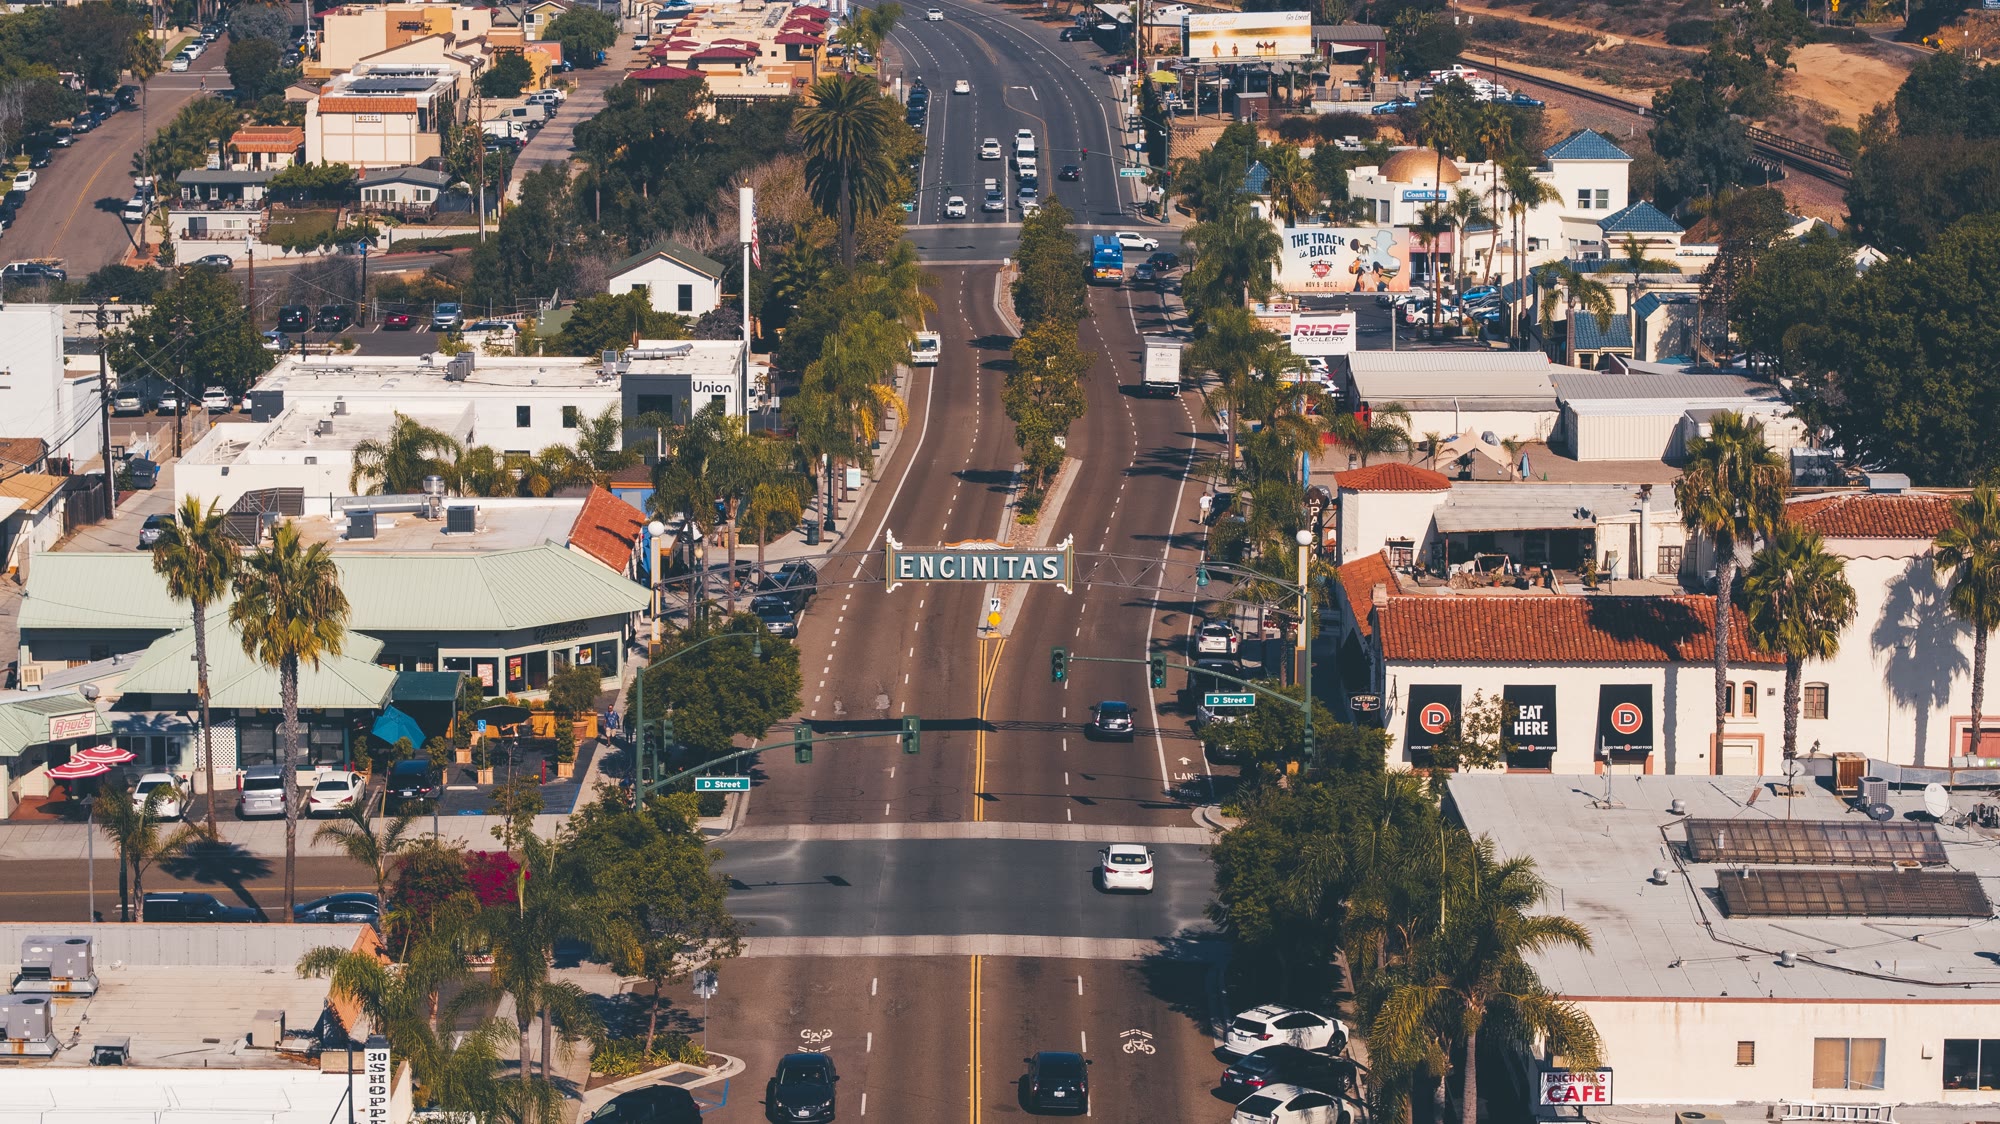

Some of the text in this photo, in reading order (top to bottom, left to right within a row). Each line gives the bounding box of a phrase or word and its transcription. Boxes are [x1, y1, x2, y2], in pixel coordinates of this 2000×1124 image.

[1291, 232, 1345, 248] THE TRACK
[1299, 245, 1337, 258] is BACK
[1293, 324, 1350, 336] RIDE
[693, 381, 732, 393] Union
[900, 556, 1058, 579] ENCINITAS
[1222, 696, 1247, 704] Street
[1427, 710, 1445, 726] D
[1519, 705, 1543, 720] EAT
[1618, 710, 1637, 727] D
[55, 718, 92, 737] RAUL'S
[1514, 721, 1548, 735] HERE
[1174, 772, 1201, 781] LANE
[704, 780, 741, 788] D Street
[368, 1052, 387, 1061] 30
[1546, 1073, 1606, 1083] ENCINIS
[1546, 1085, 1606, 1102] CAFE
